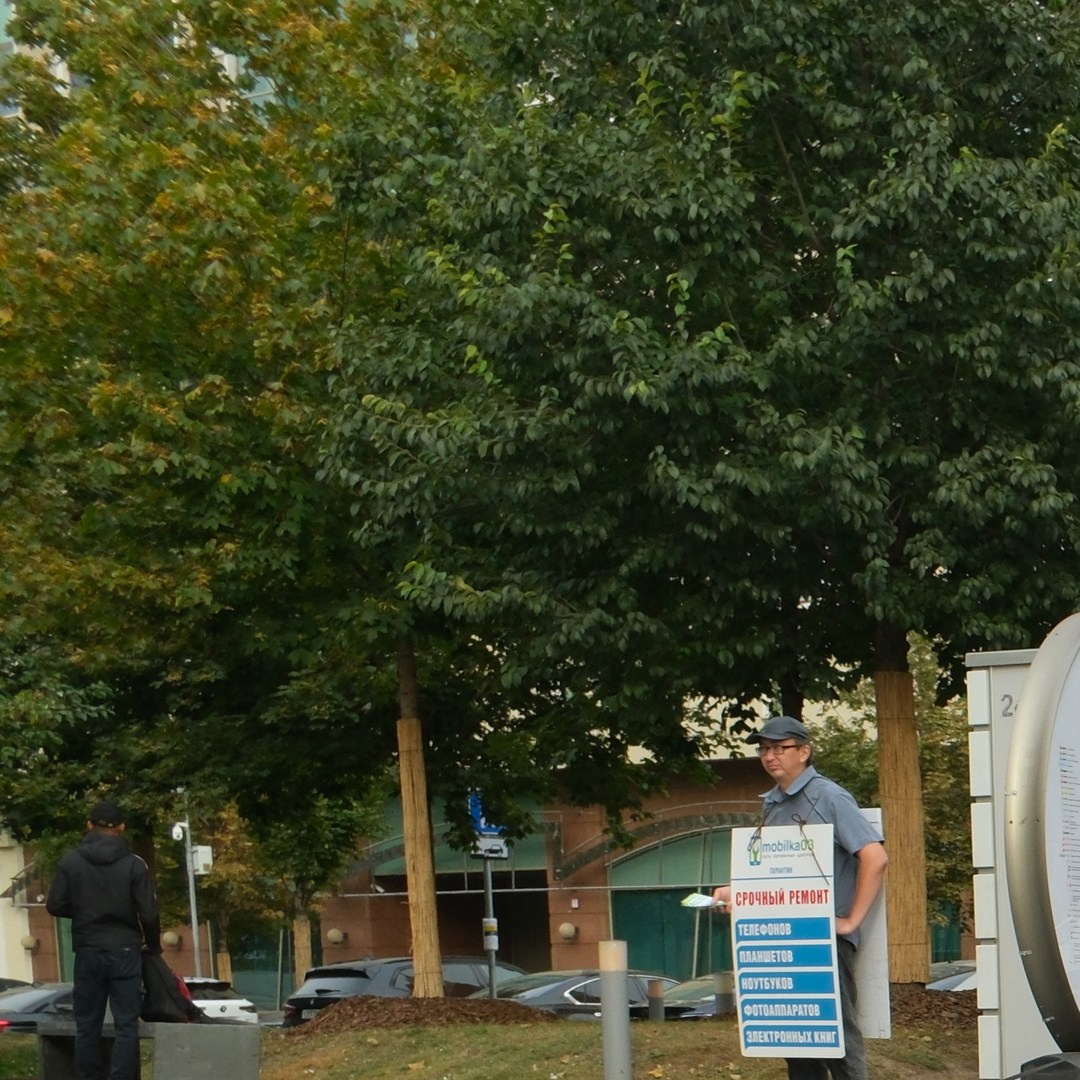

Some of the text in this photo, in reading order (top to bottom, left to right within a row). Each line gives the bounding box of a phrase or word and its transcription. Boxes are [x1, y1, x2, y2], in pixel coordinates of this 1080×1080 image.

[762, 839, 815, 852] mobilka03
[735, 888, 829, 906] СРОЧНЫЙ РЕМОНТ
[738, 923, 791, 936] ТЕЛЕФОНОВ
[740, 950, 793, 963] ПЛАНШЕТОВ
[742, 977, 793, 990] НОУТБУКОВ
[744, 1004, 820, 1017] ФОТОАППАРАТОВ
[746, 1030, 837, 1043] ЭЛЕКТРОННЫХ КНИГ
